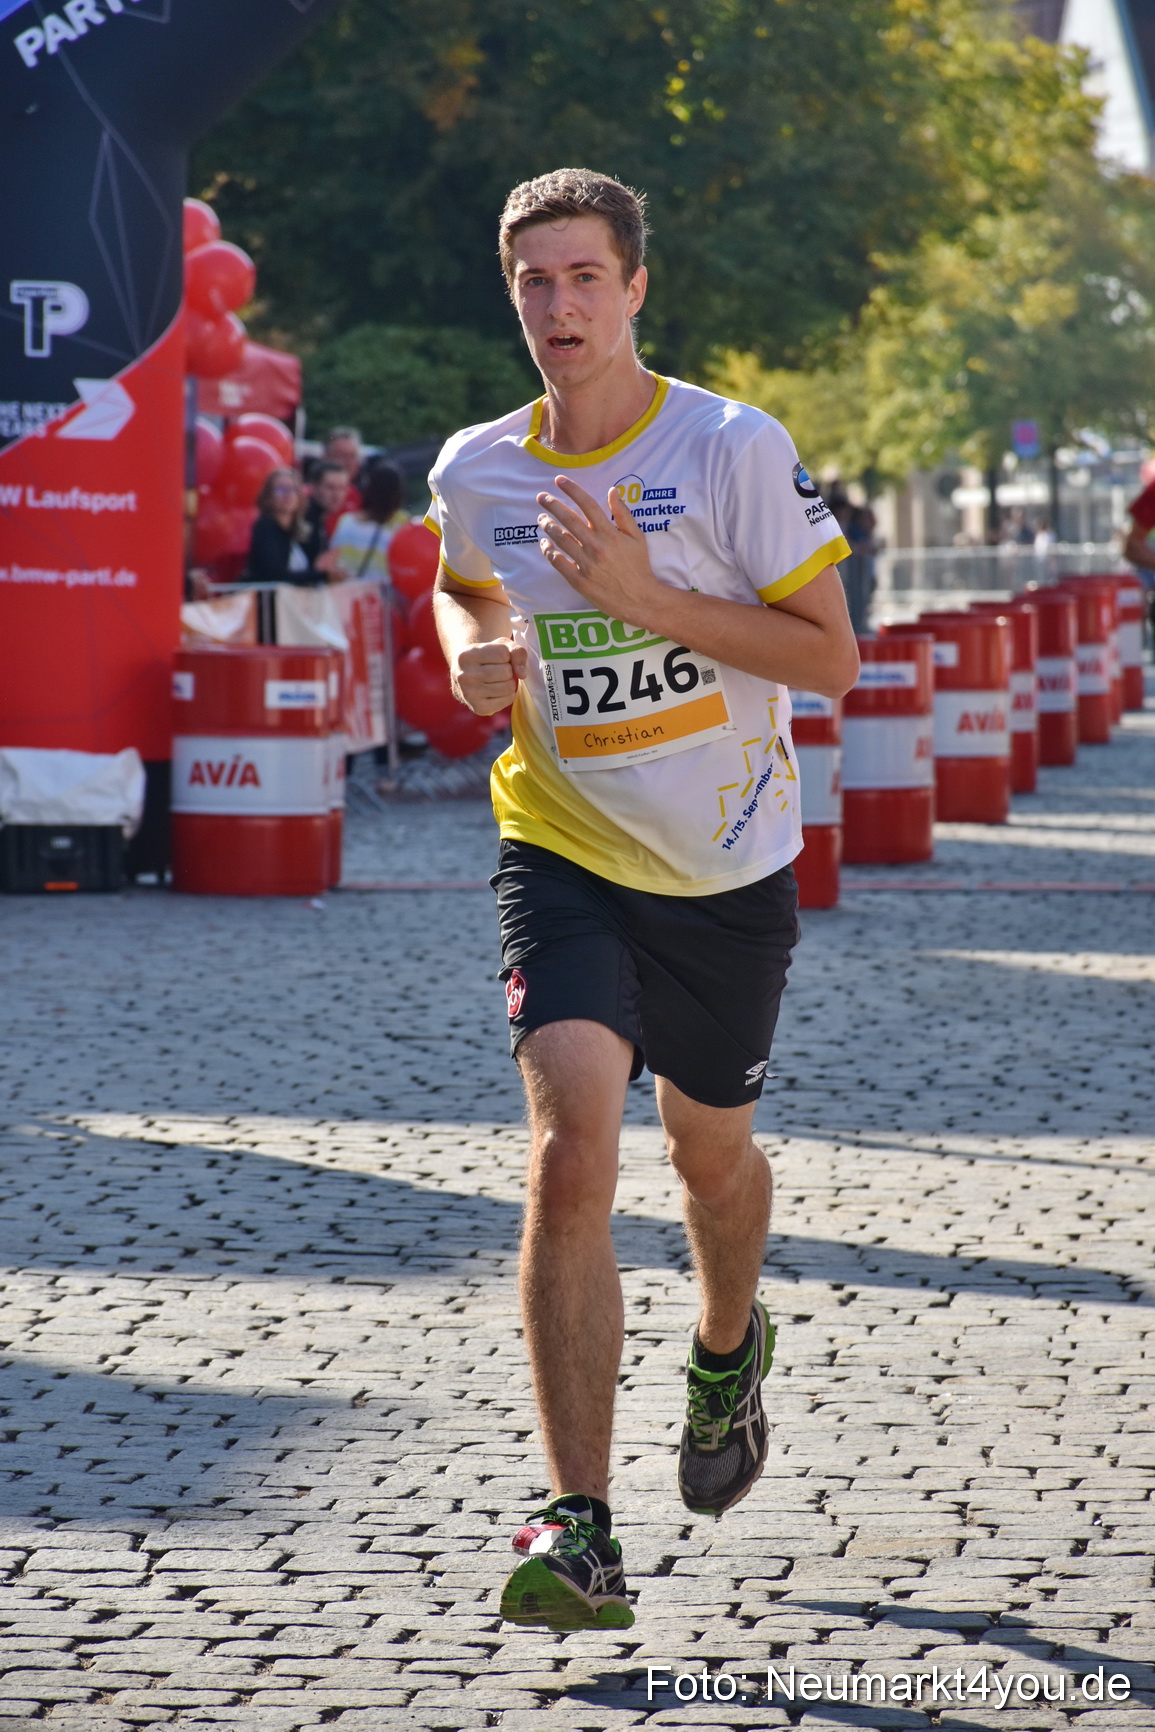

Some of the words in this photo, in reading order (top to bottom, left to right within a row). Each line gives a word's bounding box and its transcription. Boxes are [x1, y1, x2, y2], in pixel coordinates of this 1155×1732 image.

[27, 484, 136, 514] Laufsport
[645, 489, 674, 500] JAHRE
[495, 526, 538, 541] BOCK
[549, 618, 655, 649] BOC
[562, 646, 700, 716] 5246
[584, 724, 665, 748] Christian
[189, 754, 261, 788] AVIA
[722, 819, 748, 850] 14./15.
